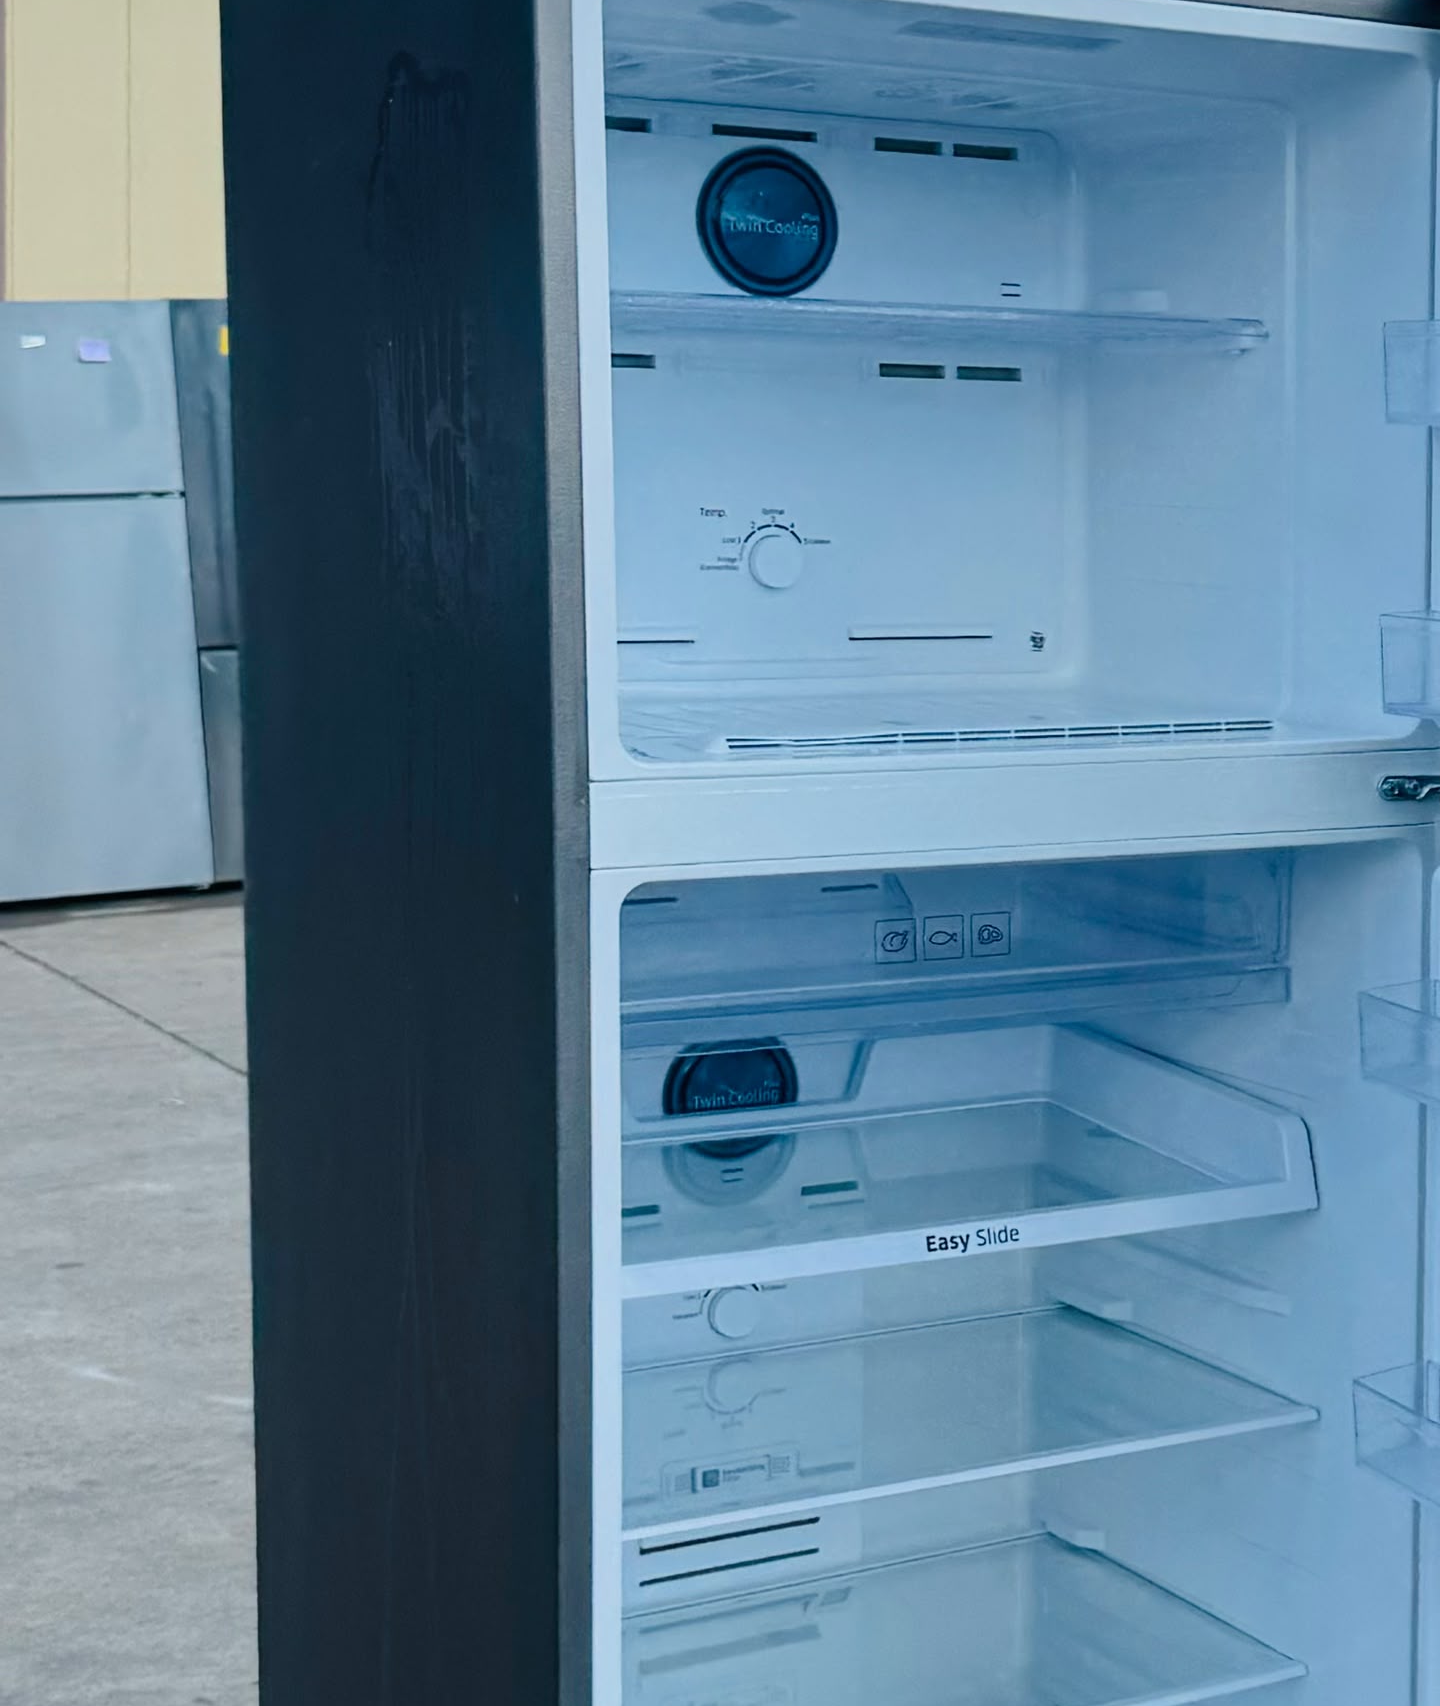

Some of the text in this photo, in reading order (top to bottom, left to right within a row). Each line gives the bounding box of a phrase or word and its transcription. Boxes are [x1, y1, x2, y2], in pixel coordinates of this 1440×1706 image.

[730, 217, 819, 241] Twin Cooling
[693, 1093, 726, 1109] Twin
[925, 1225, 1020, 1253] Easy Slide
